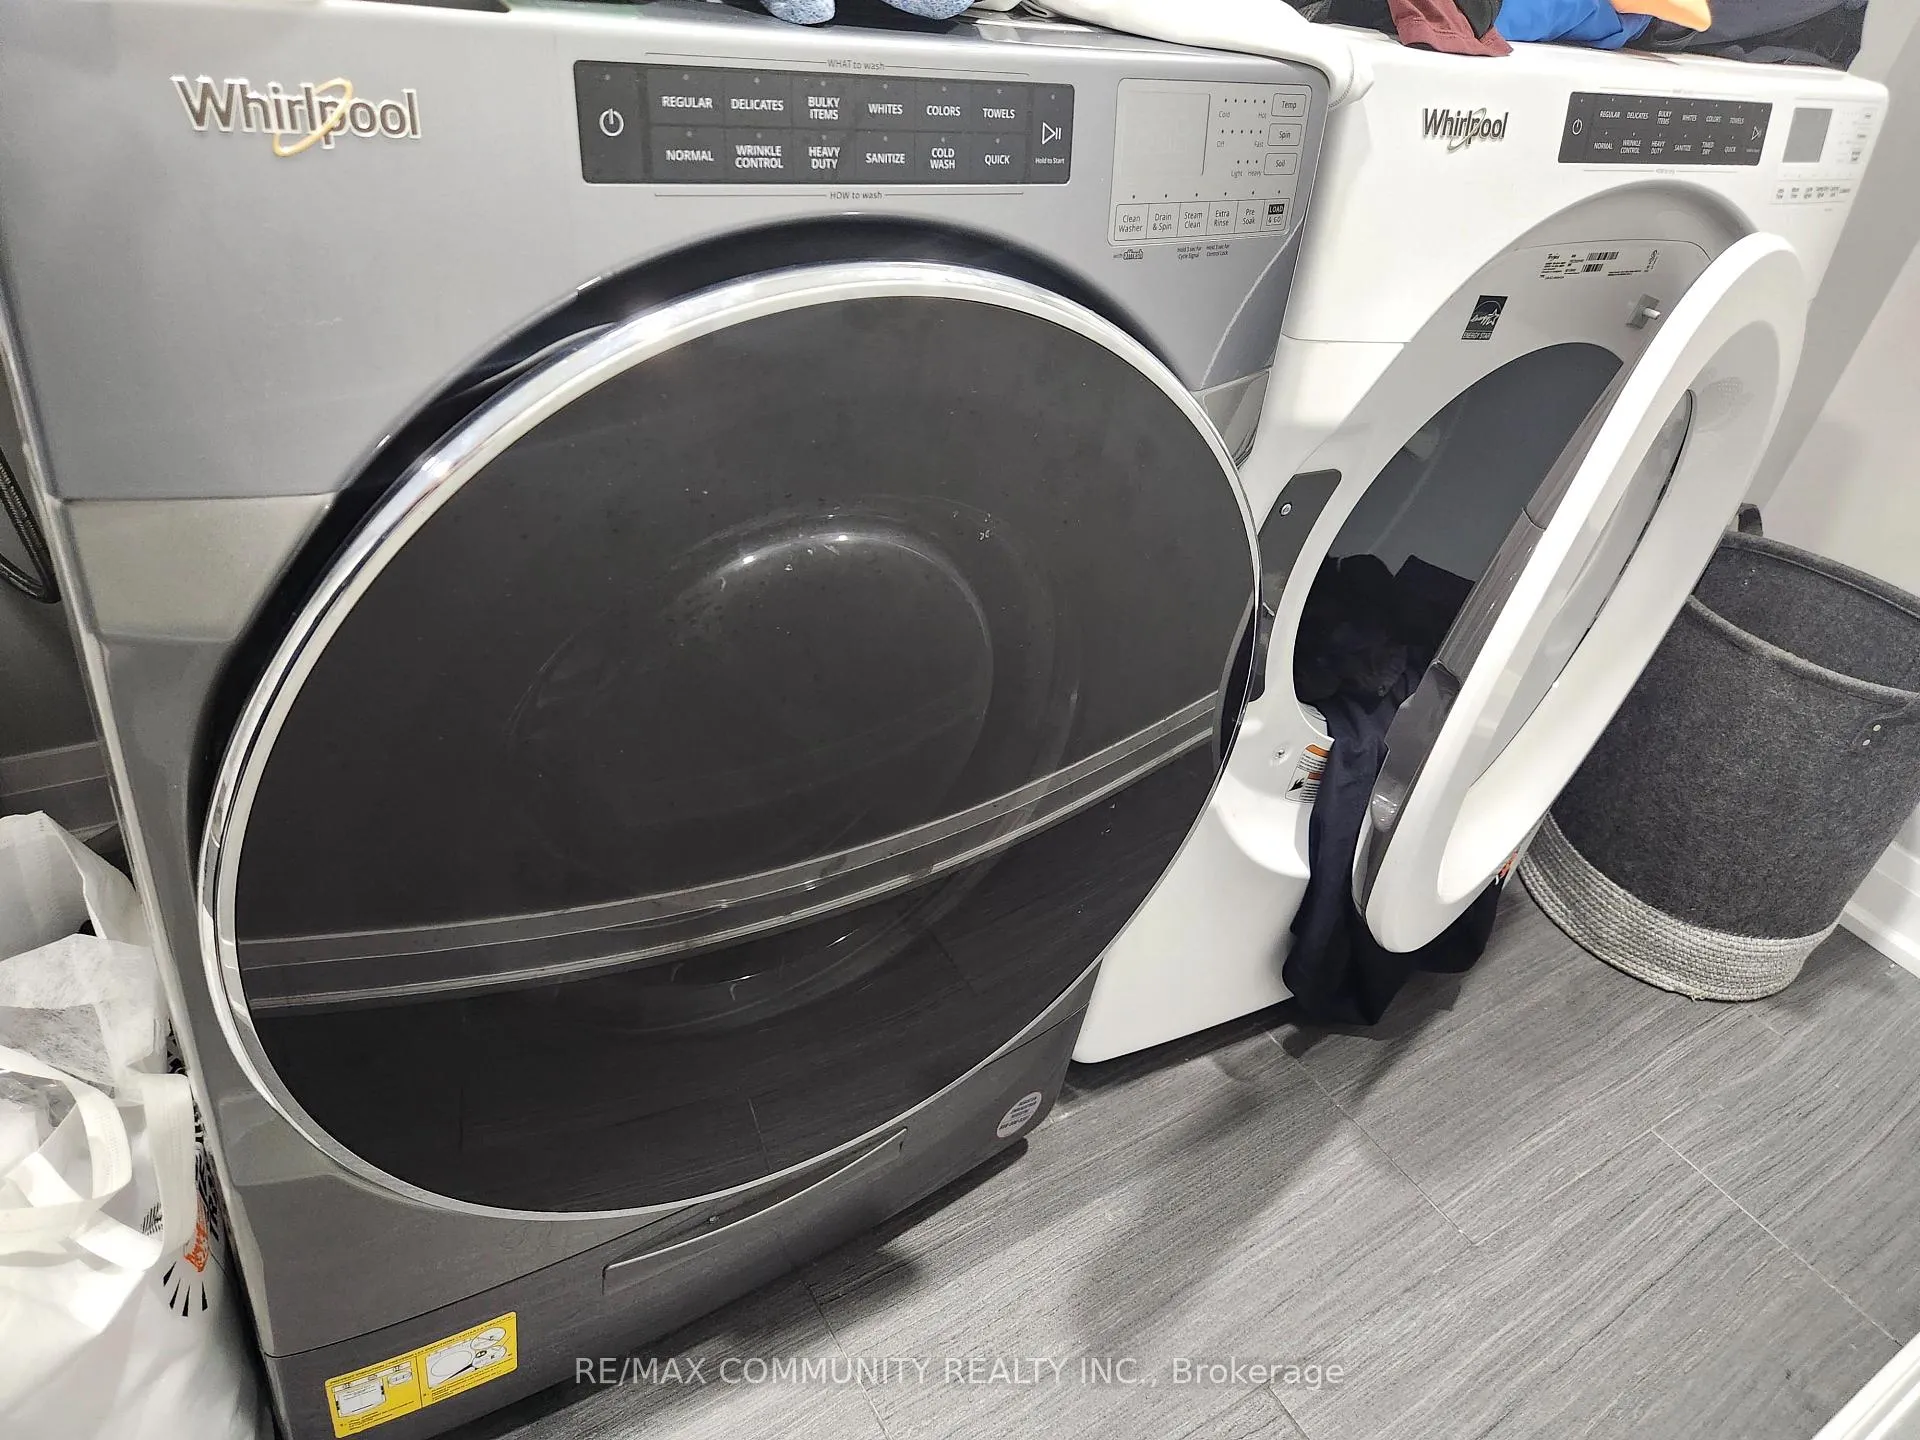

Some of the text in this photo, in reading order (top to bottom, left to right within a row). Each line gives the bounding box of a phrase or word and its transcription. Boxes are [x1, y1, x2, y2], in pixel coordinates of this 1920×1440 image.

[827, 59, 851, 68] WHAT
[864, 62, 885, 71] wash
[661, 96, 713, 109] REGULAR
[730, 98, 784, 111] DELICATES
[807, 96, 840, 108] BULKY
[1281, 100, 1297, 111] Temp
[169, 74, 422, 150] Whirlpool
[809, 108, 839, 120] ITEMS
[868, 103, 903, 115] WHITES
[926, 105, 961, 117] COLORS
[982, 107, 1016, 120] TOWELS
[1218, 110, 1231, 118] Cold
[1599, 110, 1621, 119] REGULAR
[1657, 110, 1672, 118] BULKY
[1626, 111, 1649, 120] DELICATES
[1705, 115, 1722, 123] COLORS
[1423, 107, 1509, 146] Whirlpool
[1279, 130, 1291, 141] Spin
[1593, 142, 1614, 150] NORMAL
[1622, 139, 1641, 147] WRINKLE
[1651, 140, 1666, 148] HEAVY
[665, 149, 714, 162] NORMAL
[735, 145, 782, 157] WRINKLE
[808, 146, 841, 157] HEAVY
[931, 147, 955, 159] COLD
[1650, 147, 1664, 155] DUTY
[735, 157, 783, 169] CONTROL
[810, 158, 838, 170] DUTY
[865, 152, 906, 165] SANITIZE
[930, 158, 956, 170] WASH
[984, 154, 1011, 166] QUICK
[1230, 170, 1243, 179] Light
[830, 191, 883, 200] HOW to wash
[1215, 209, 1230, 218] Extra
[1245, 208, 1256, 217] Pre
[1269, 205, 1284, 214] LOAD
[1122, 214, 1141, 224] Clean
[1154, 212, 1172, 222] Drain
[1184, 211, 1203, 220] Steam
[1184, 220, 1201, 229] Clean
[1213, 219, 1230, 228] Rinse
[1242, 217, 1256, 226] Soak
[1118, 224, 1143, 234] Washer
[1152, 222, 1172, 233] & Spin
